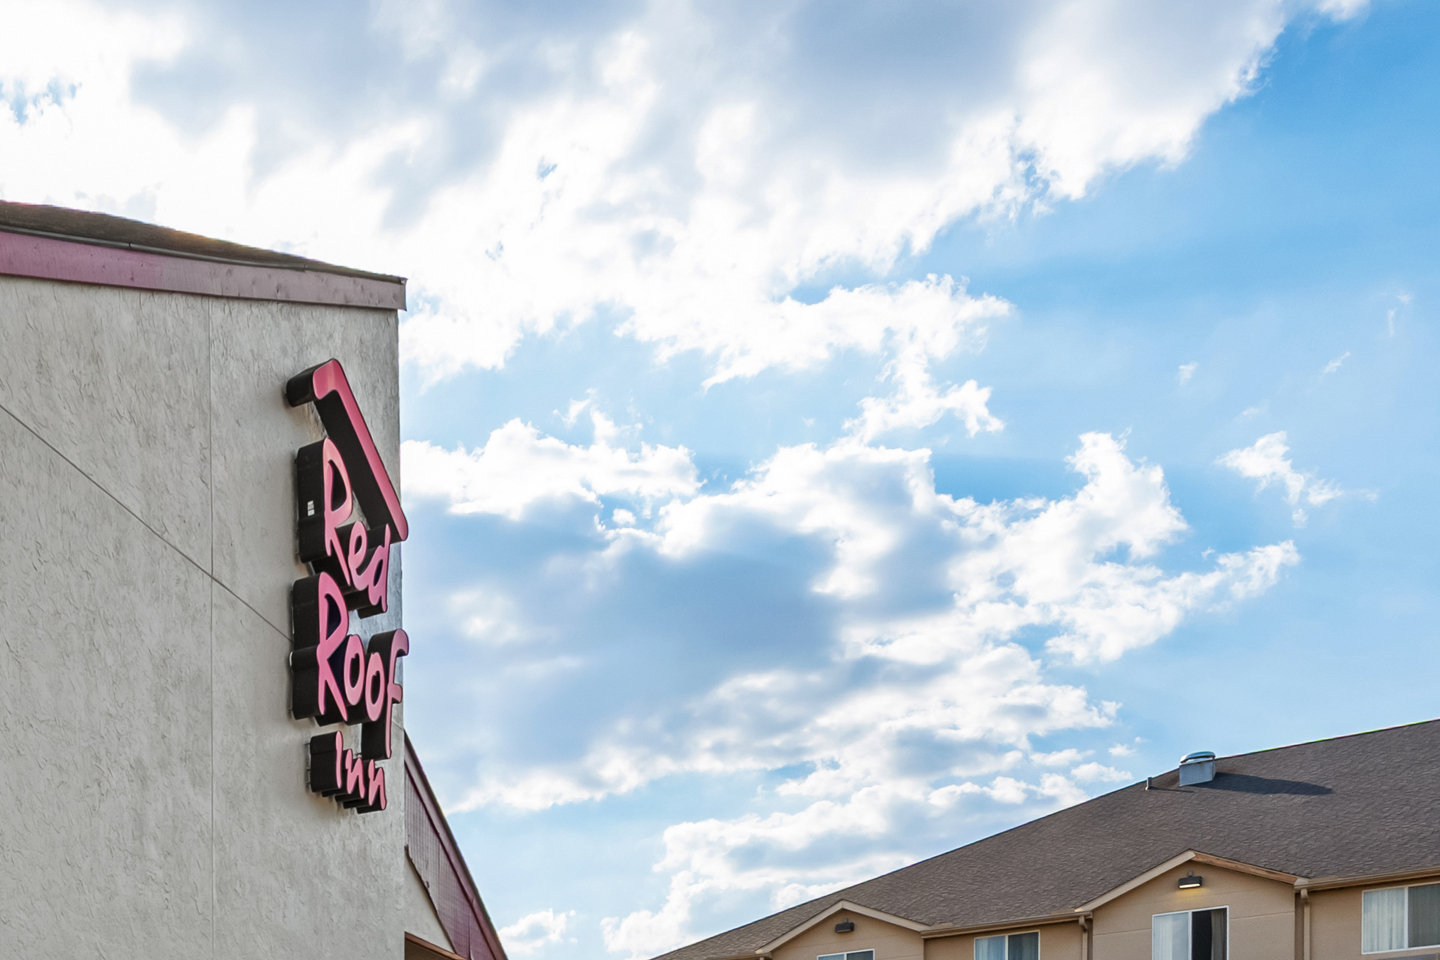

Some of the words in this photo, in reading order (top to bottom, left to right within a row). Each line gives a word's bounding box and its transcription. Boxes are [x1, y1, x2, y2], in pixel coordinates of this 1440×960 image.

[322, 437, 391, 613] Red
[316, 571, 409, 759] Roof
[336, 731, 387, 811] Inn
